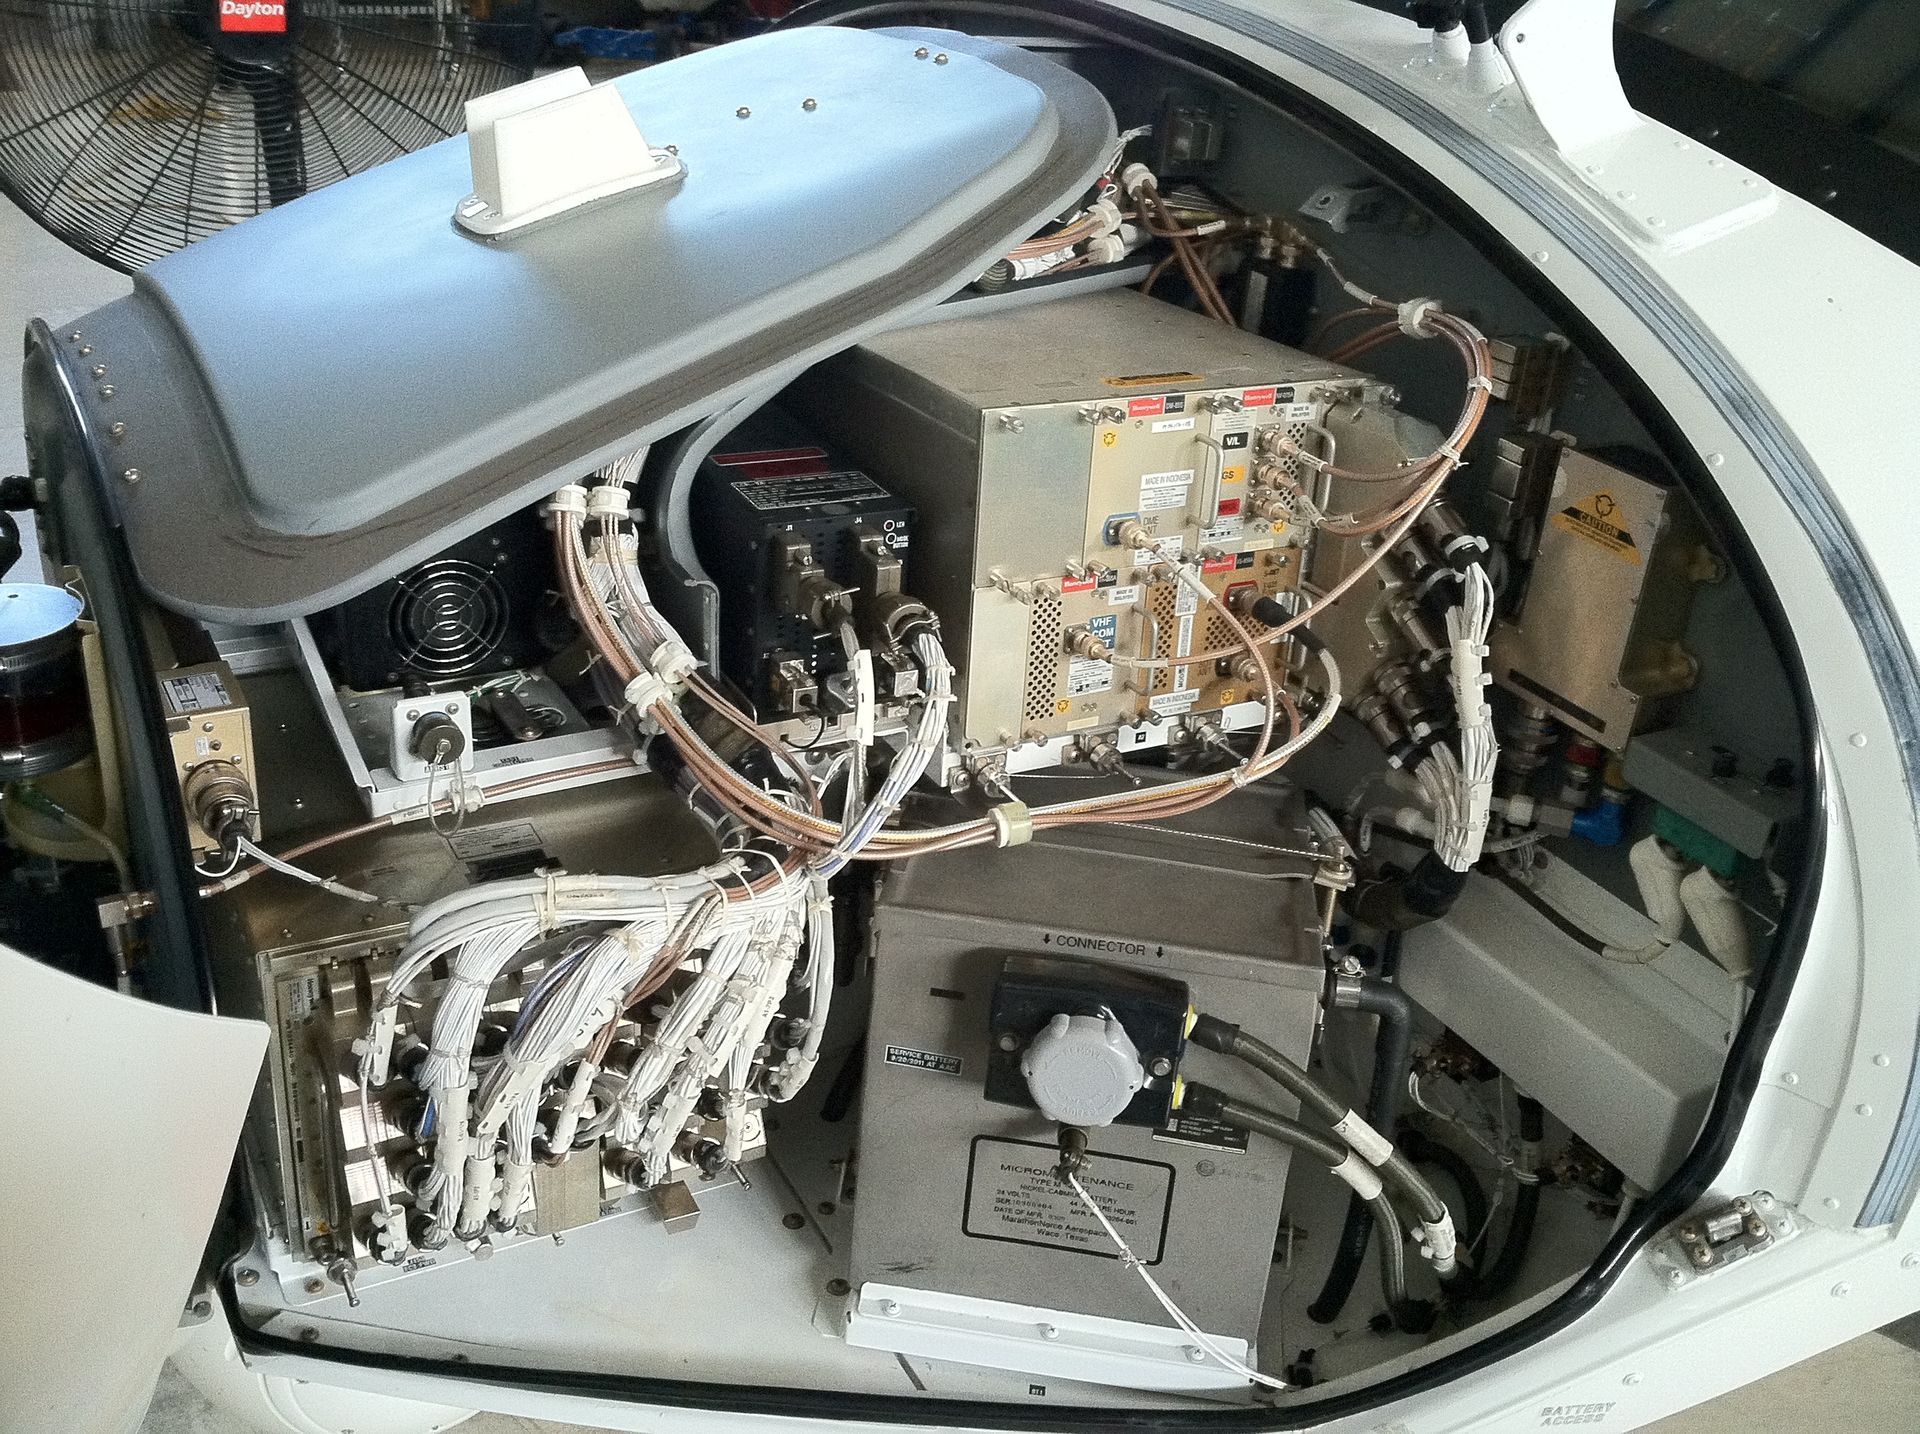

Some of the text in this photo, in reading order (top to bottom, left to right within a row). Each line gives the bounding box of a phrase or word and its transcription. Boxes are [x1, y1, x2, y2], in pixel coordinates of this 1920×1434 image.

[222, 1, 284, 18] Dayton
[1145, 477, 1160, 485] MADE
[1166, 473, 1192, 482] INDONESIA
[1143, 516, 1160, 525] DME
[1580, 512, 1618, 538] CAUTION
[1092, 617, 1113, 627] VHF
[1091, 628, 1114, 638] COM
[1056, 935, 1146, 956] CONNECTOR
[889, 1048, 958, 1065] SERVICE BATTERY
[1000, 1163, 1135, 1191] MICROMTENANCE
[1030, 1177, 1052, 1187] TYPE
[1006, 1190, 1030, 1198] VOLTS
[1113, 1208, 1136, 1216] HOUR
[1090, 1194, 1118, 1205] ATTERY
[993, 1206, 1013, 1214] DATE
[1064, 1232, 1089, 1242] Texas
[1065, 1224, 1108, 1237] Aerospace
[1541, 1402, 1616, 1416] BATTERY
[1540, 1413, 1605, 1426] ACCESS
